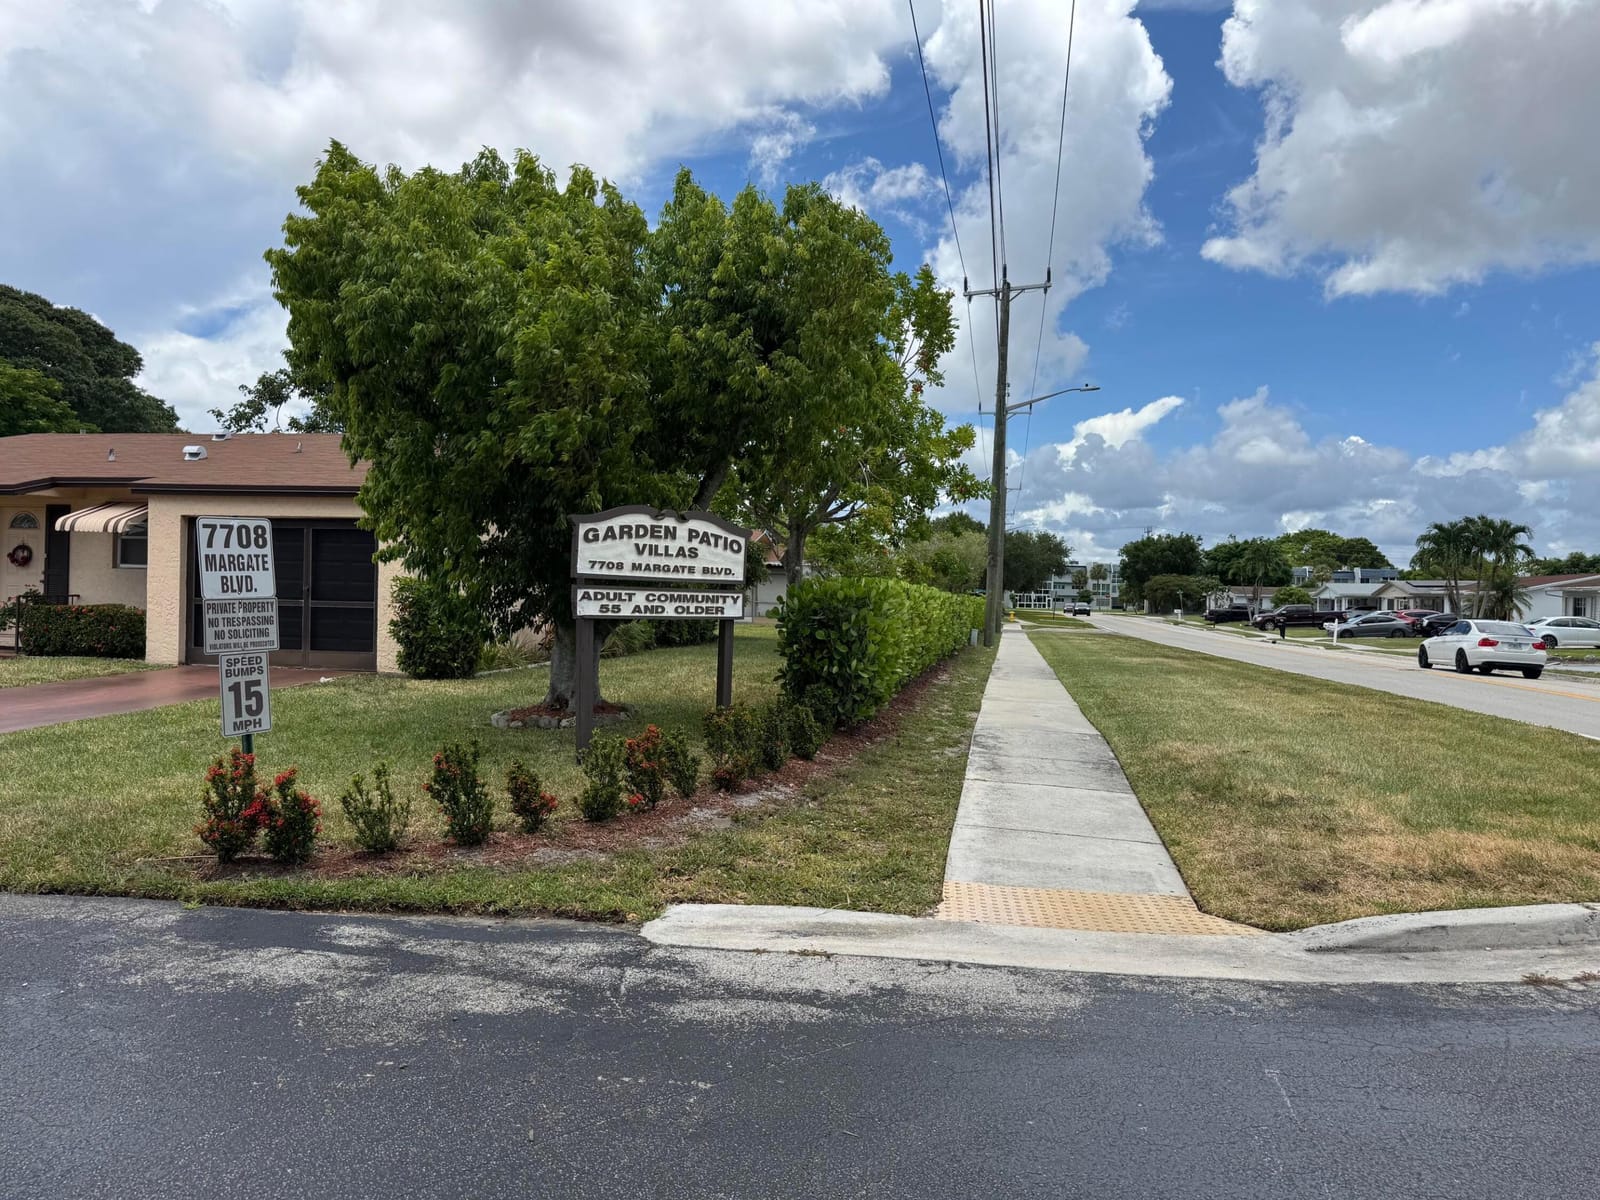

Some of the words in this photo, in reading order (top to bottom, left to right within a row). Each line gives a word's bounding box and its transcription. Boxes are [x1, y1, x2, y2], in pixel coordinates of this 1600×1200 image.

[202, 523, 268, 549] 7708
[582, 524, 677, 543] GARDEN
[687, 528, 743, 554] PATIO
[634, 542, 699, 559] VILLAS
[204, 553, 270, 572] MARGATE
[588, 560, 625, 571] 7708
[631, 562, 696, 575] MARGATE
[702, 566, 736, 577] BLVD.
[220, 575, 258, 594] BLVD.
[579, 590, 636, 602] ADULT
[645, 592, 741, 605] COMMUNITY
[206, 602, 237, 615] PRIVATE
[238, 601, 275, 614] PROPERTY
[598, 604, 622, 614] 55
[631, 604, 666, 615] AND
[674, 605, 726, 616] OLDER
[208, 617, 220, 628] NO
[222, 615, 275, 627] TRESPASSING
[214, 629, 226, 641] NO
[227, 627, 270, 639] SOLICITING
[225, 656, 263, 668] SPEED
[225, 665, 264, 678] BUMPS
[228, 679, 264, 719] 15
[232, 718, 262, 732] MPH
